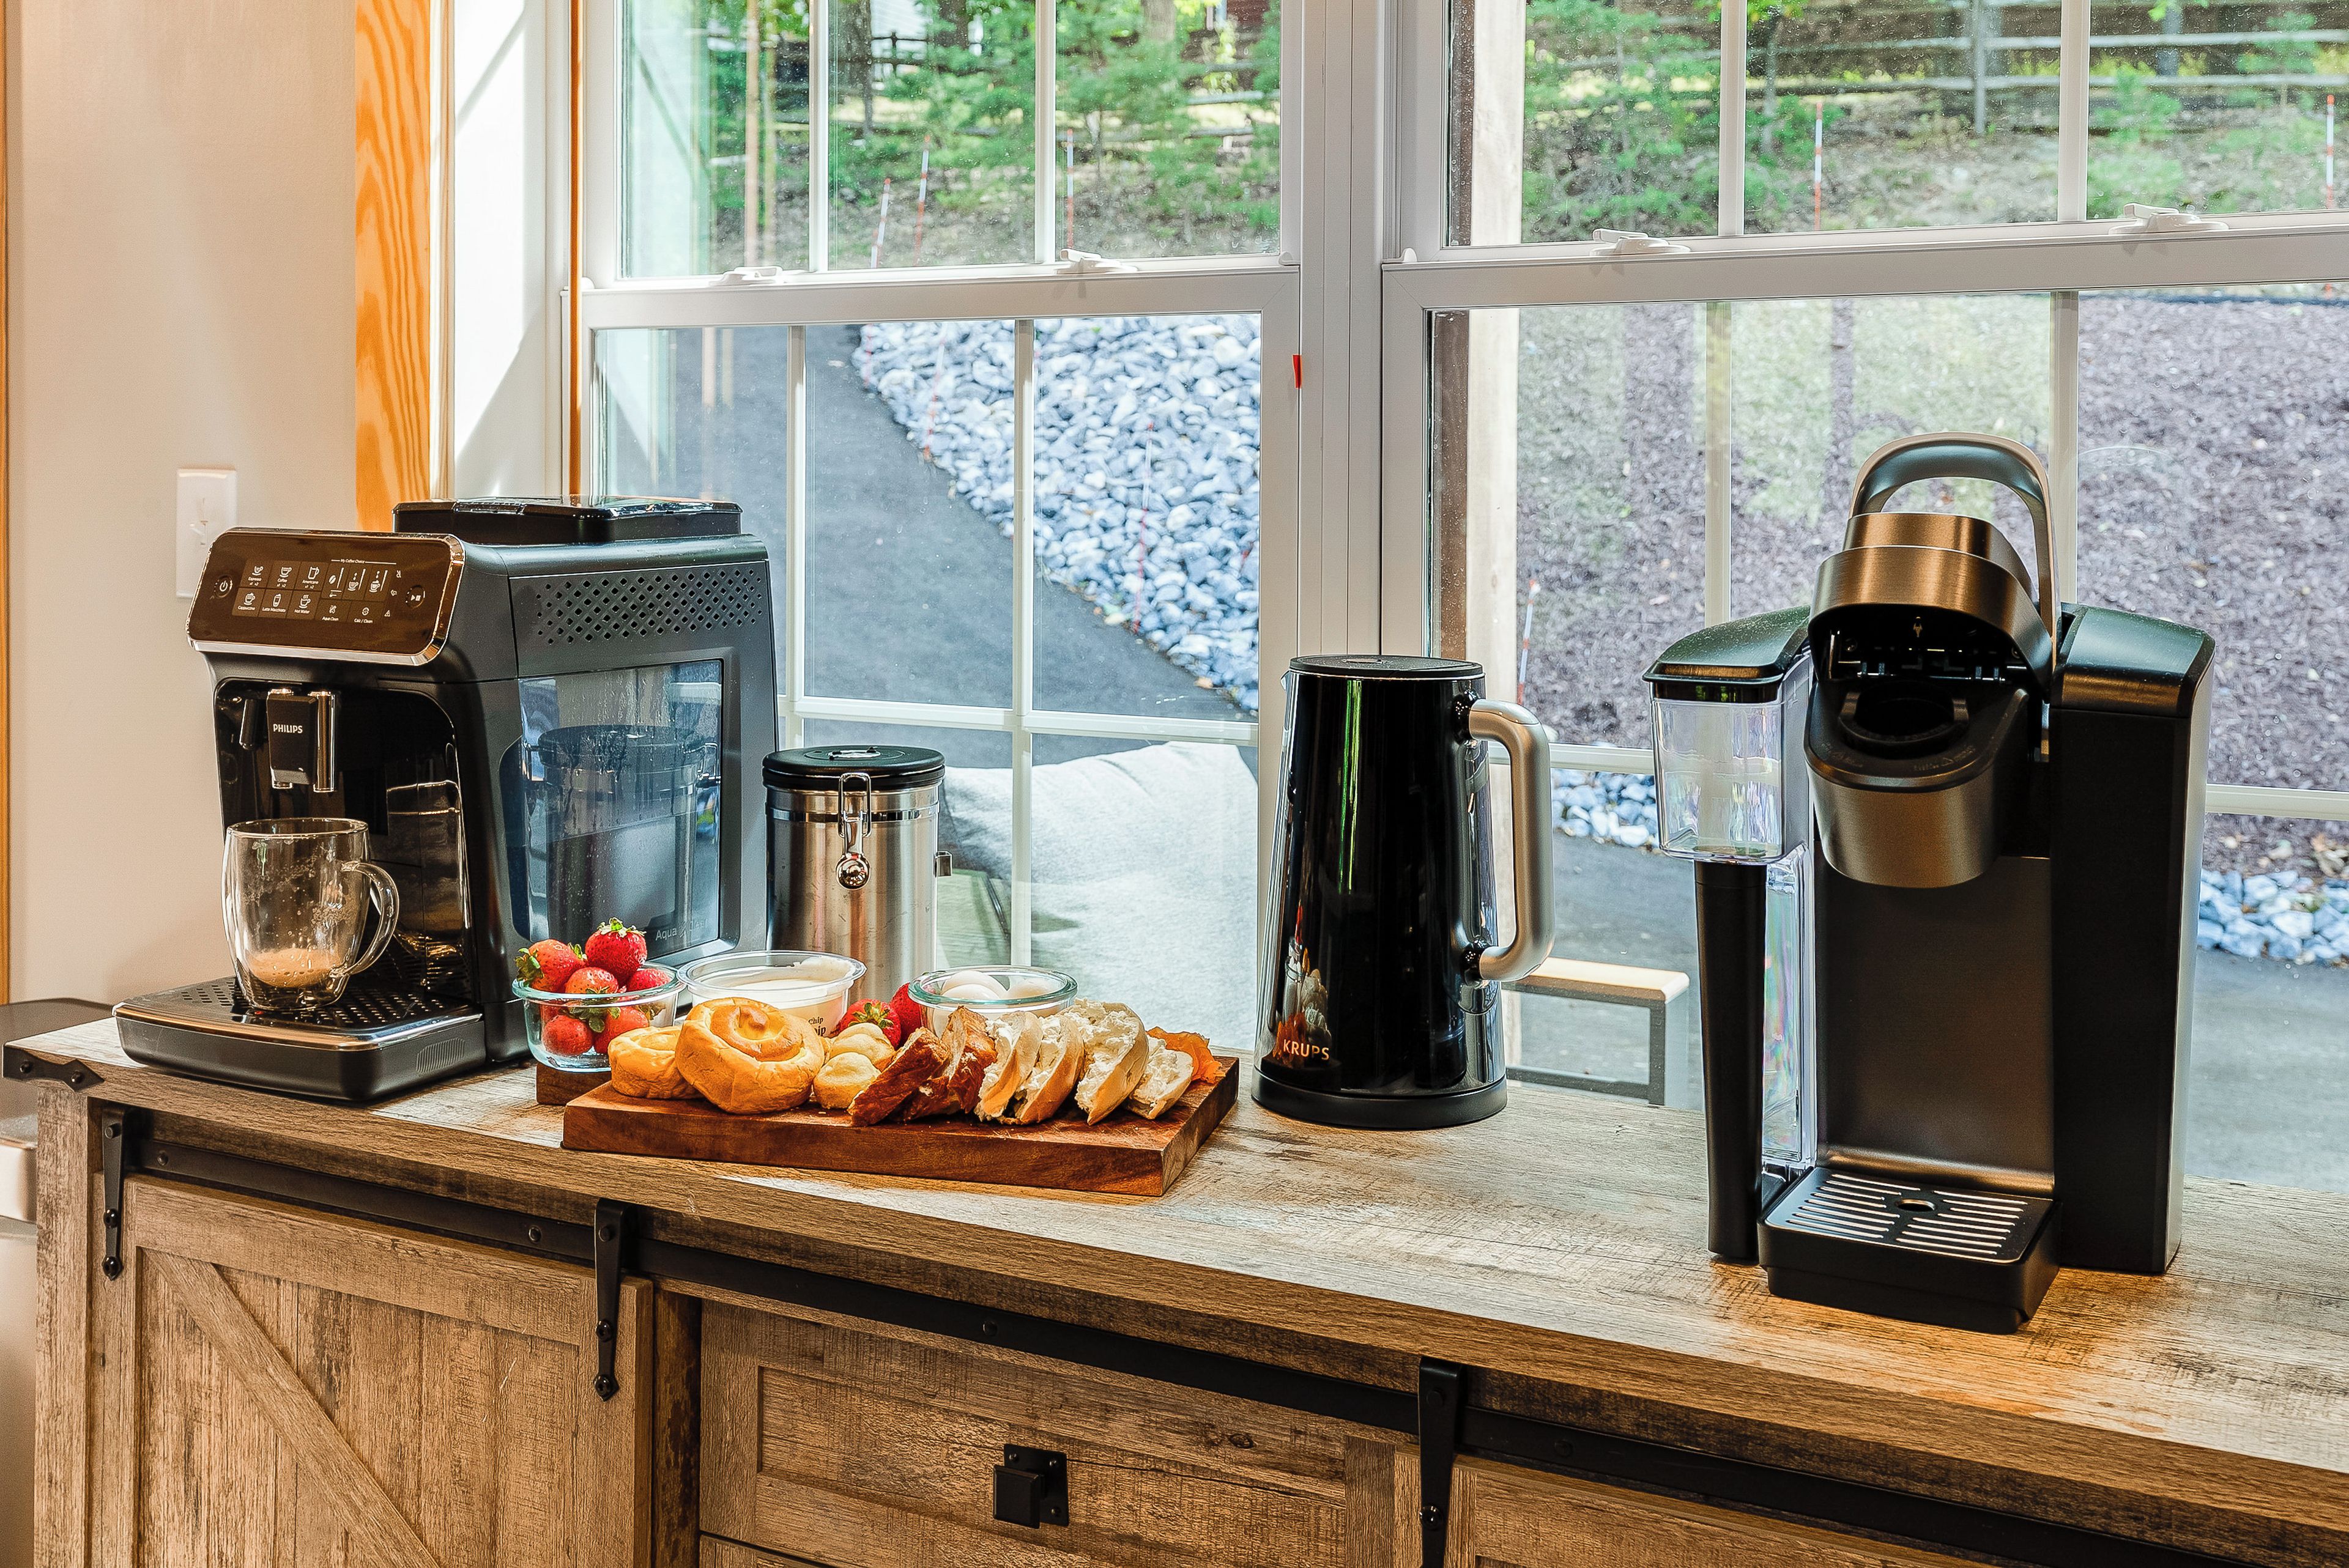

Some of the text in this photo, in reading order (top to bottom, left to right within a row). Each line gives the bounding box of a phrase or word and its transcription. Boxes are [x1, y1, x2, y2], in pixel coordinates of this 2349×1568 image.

[272, 723, 304, 734] PHILIPS
[655, 928, 677, 941] Aqua
[808, 1016, 824, 1025] Chip
[814, 1025, 827, 1037] ip
[1283, 1038, 1330, 1061] KRUPS
